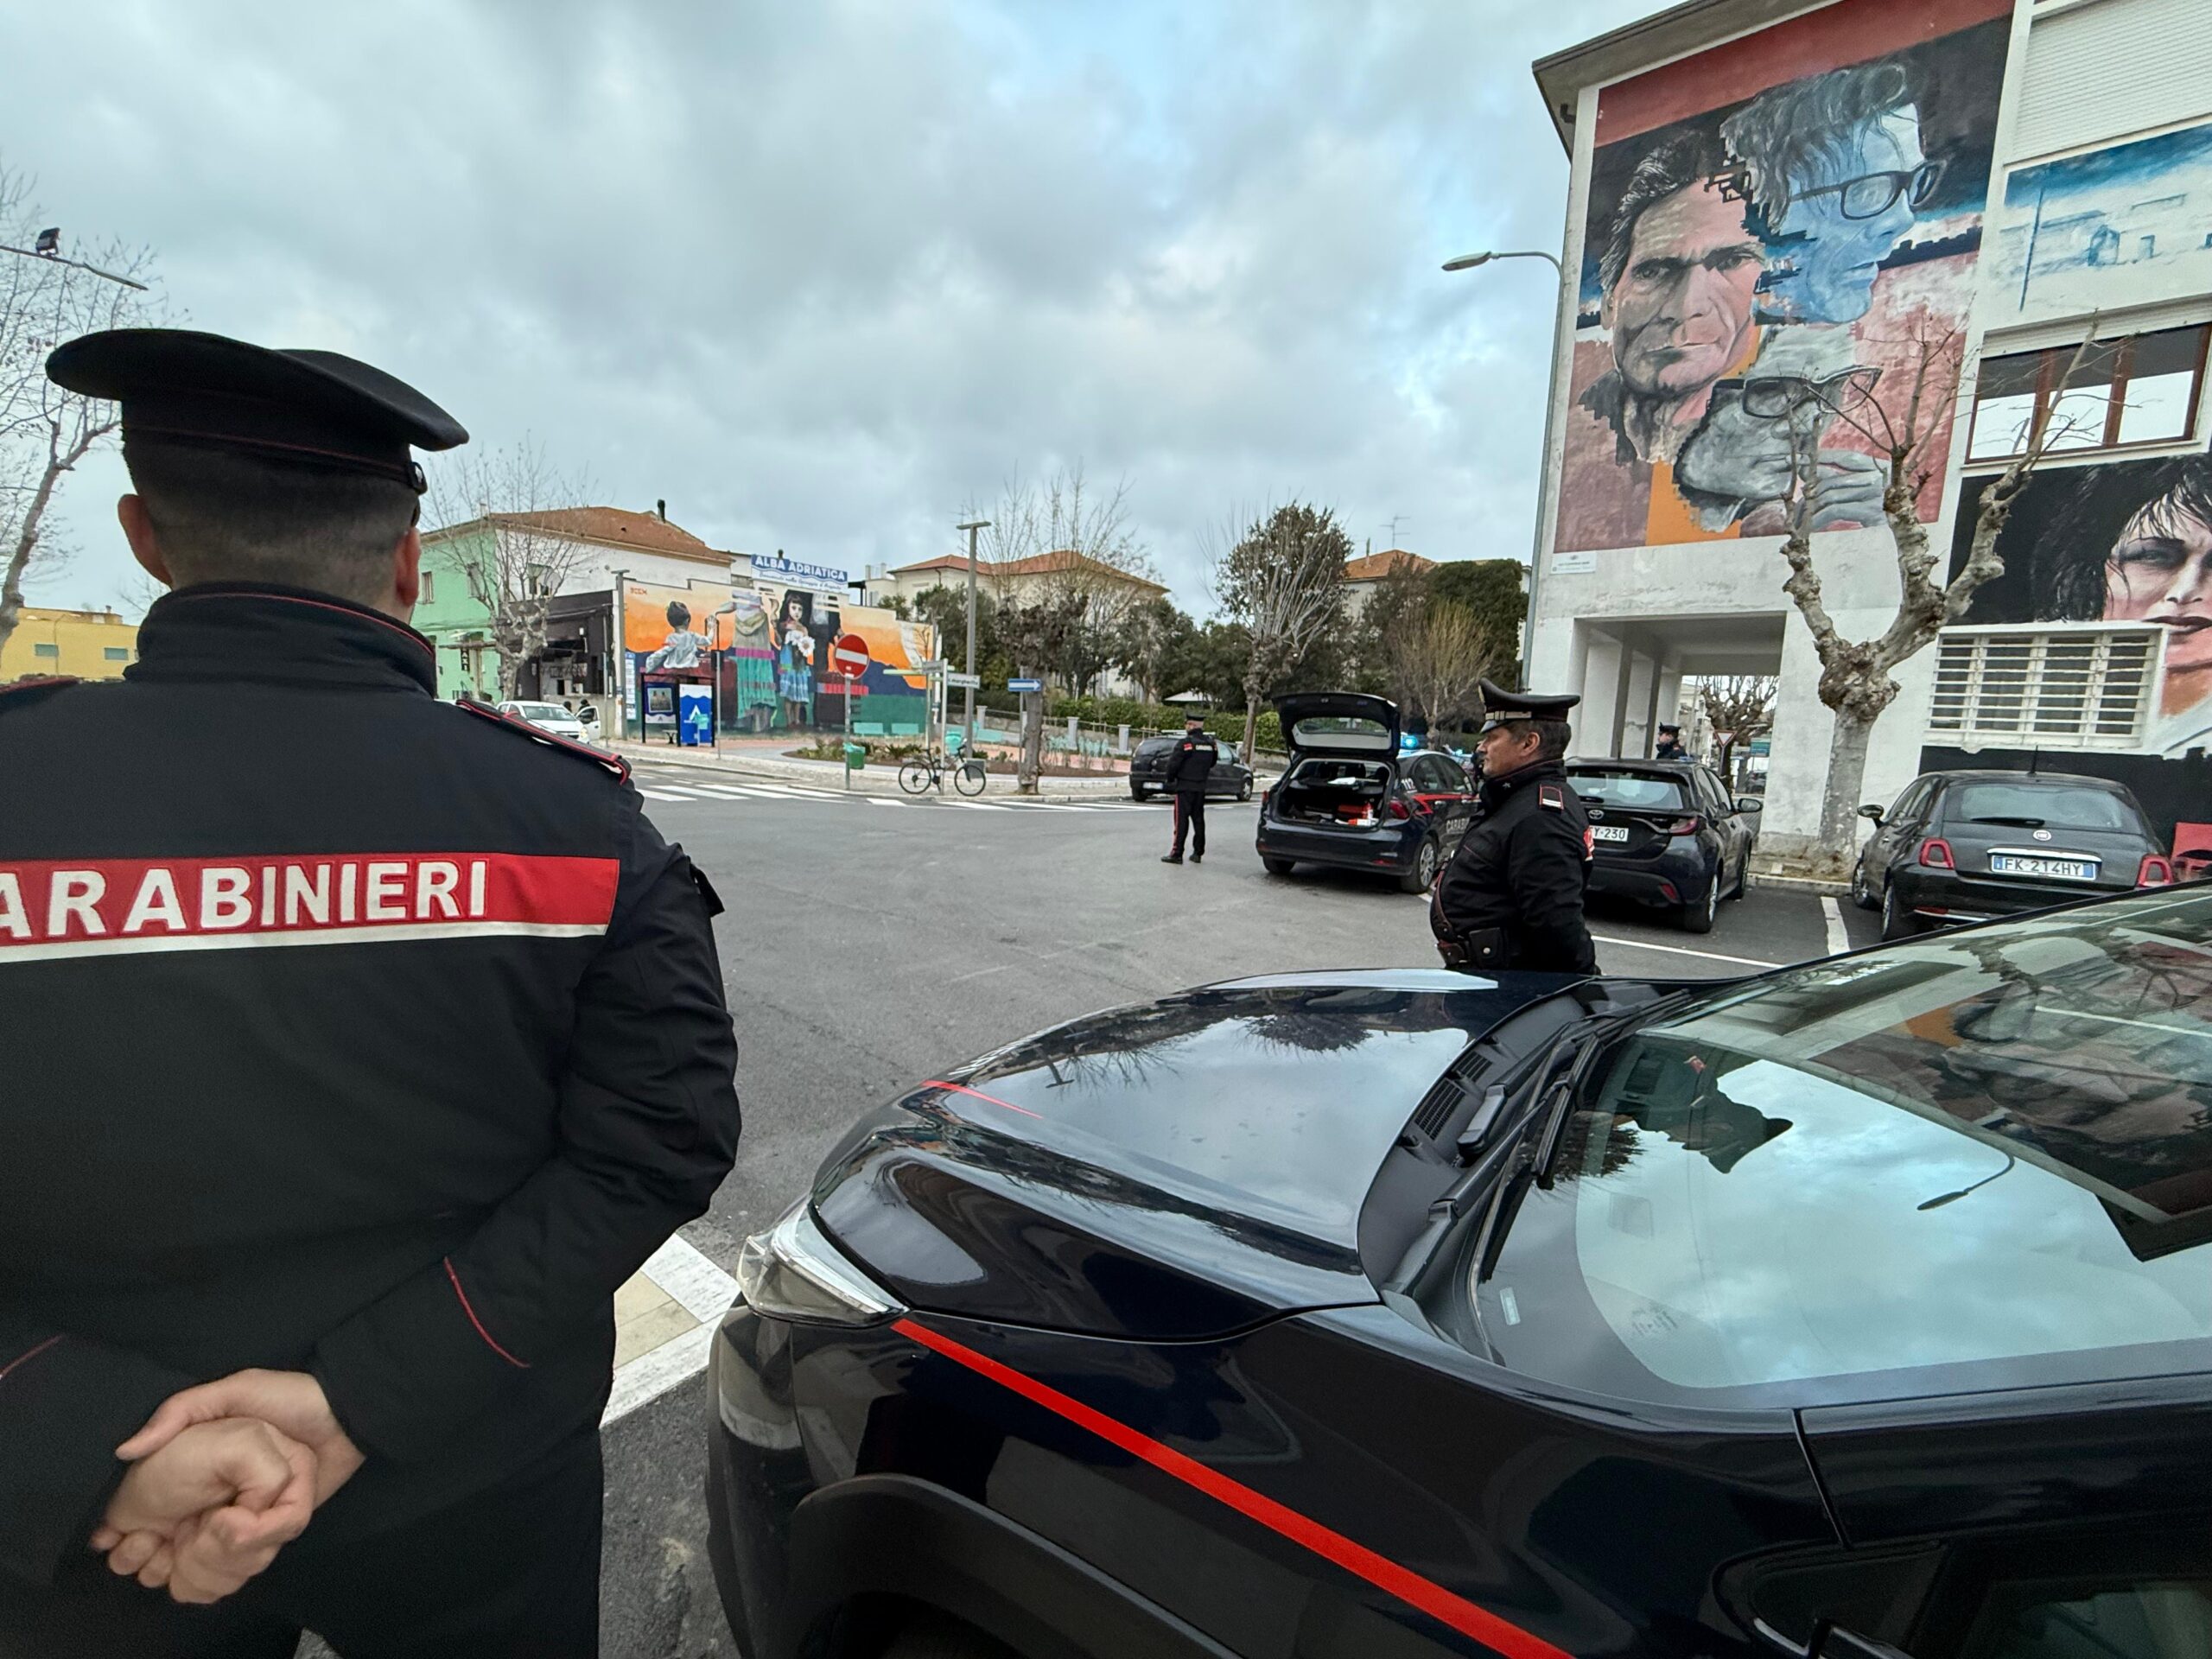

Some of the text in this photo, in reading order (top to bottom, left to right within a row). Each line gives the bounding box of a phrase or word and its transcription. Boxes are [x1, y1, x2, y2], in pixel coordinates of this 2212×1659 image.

[754, 556, 845, 582] ALBA ADRIATICA
[1402, 778, 1416, 790] 112
